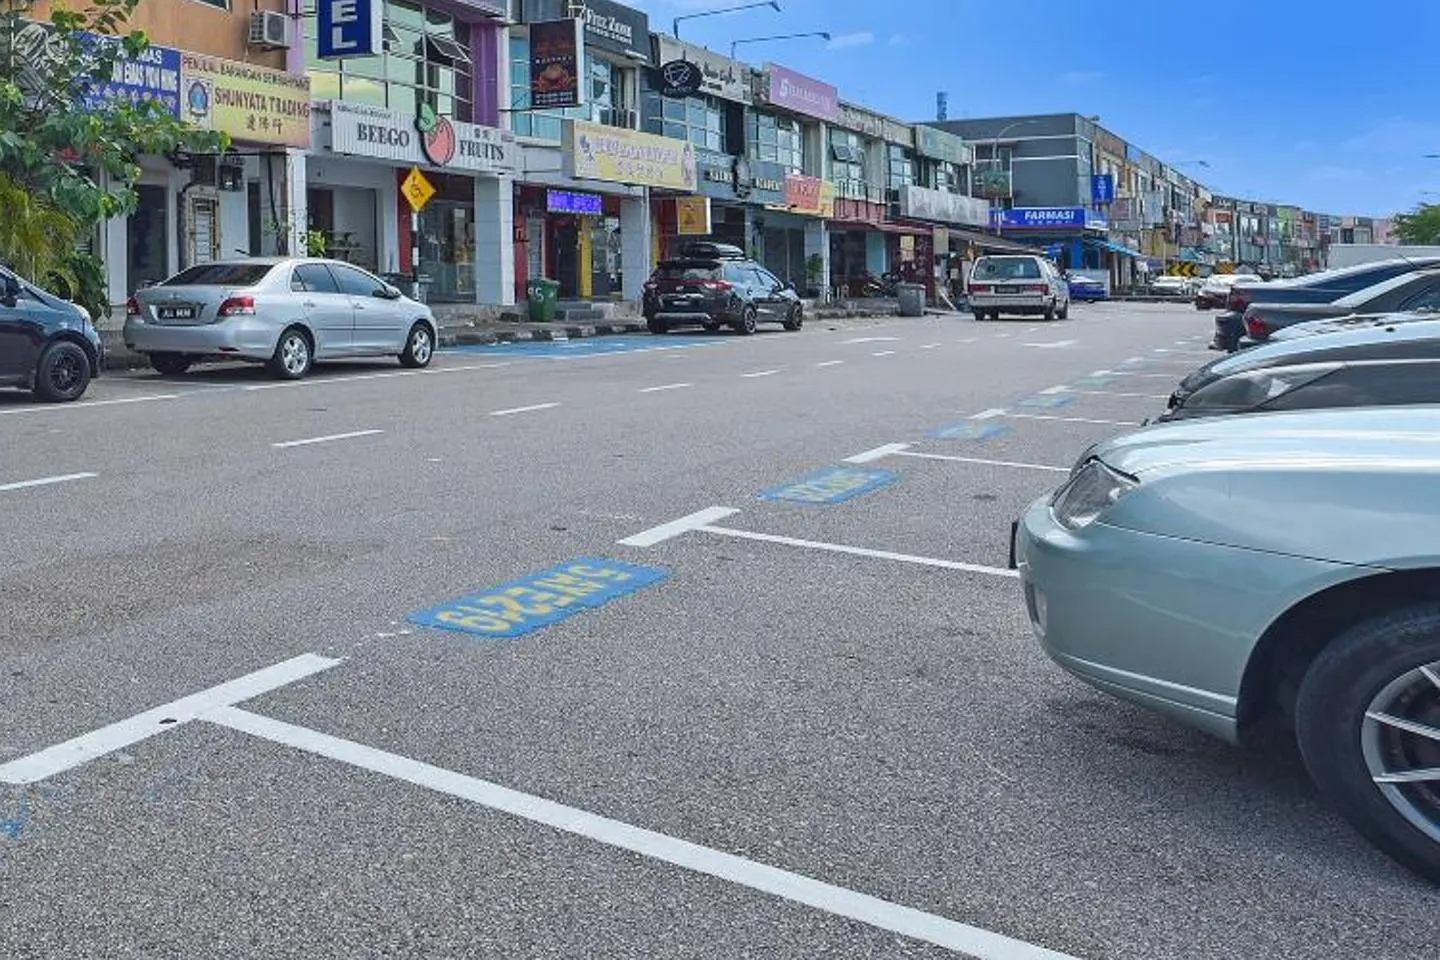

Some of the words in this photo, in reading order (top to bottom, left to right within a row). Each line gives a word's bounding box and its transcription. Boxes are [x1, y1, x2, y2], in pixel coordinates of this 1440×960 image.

[215, 87, 267, 113] SHUNYATA
[268, 95, 310, 119] TRADING
[357, 122, 410, 148] BEEGO
[460, 139, 505, 161] FRUITS
[1024, 210, 1075, 221] FARMASI
